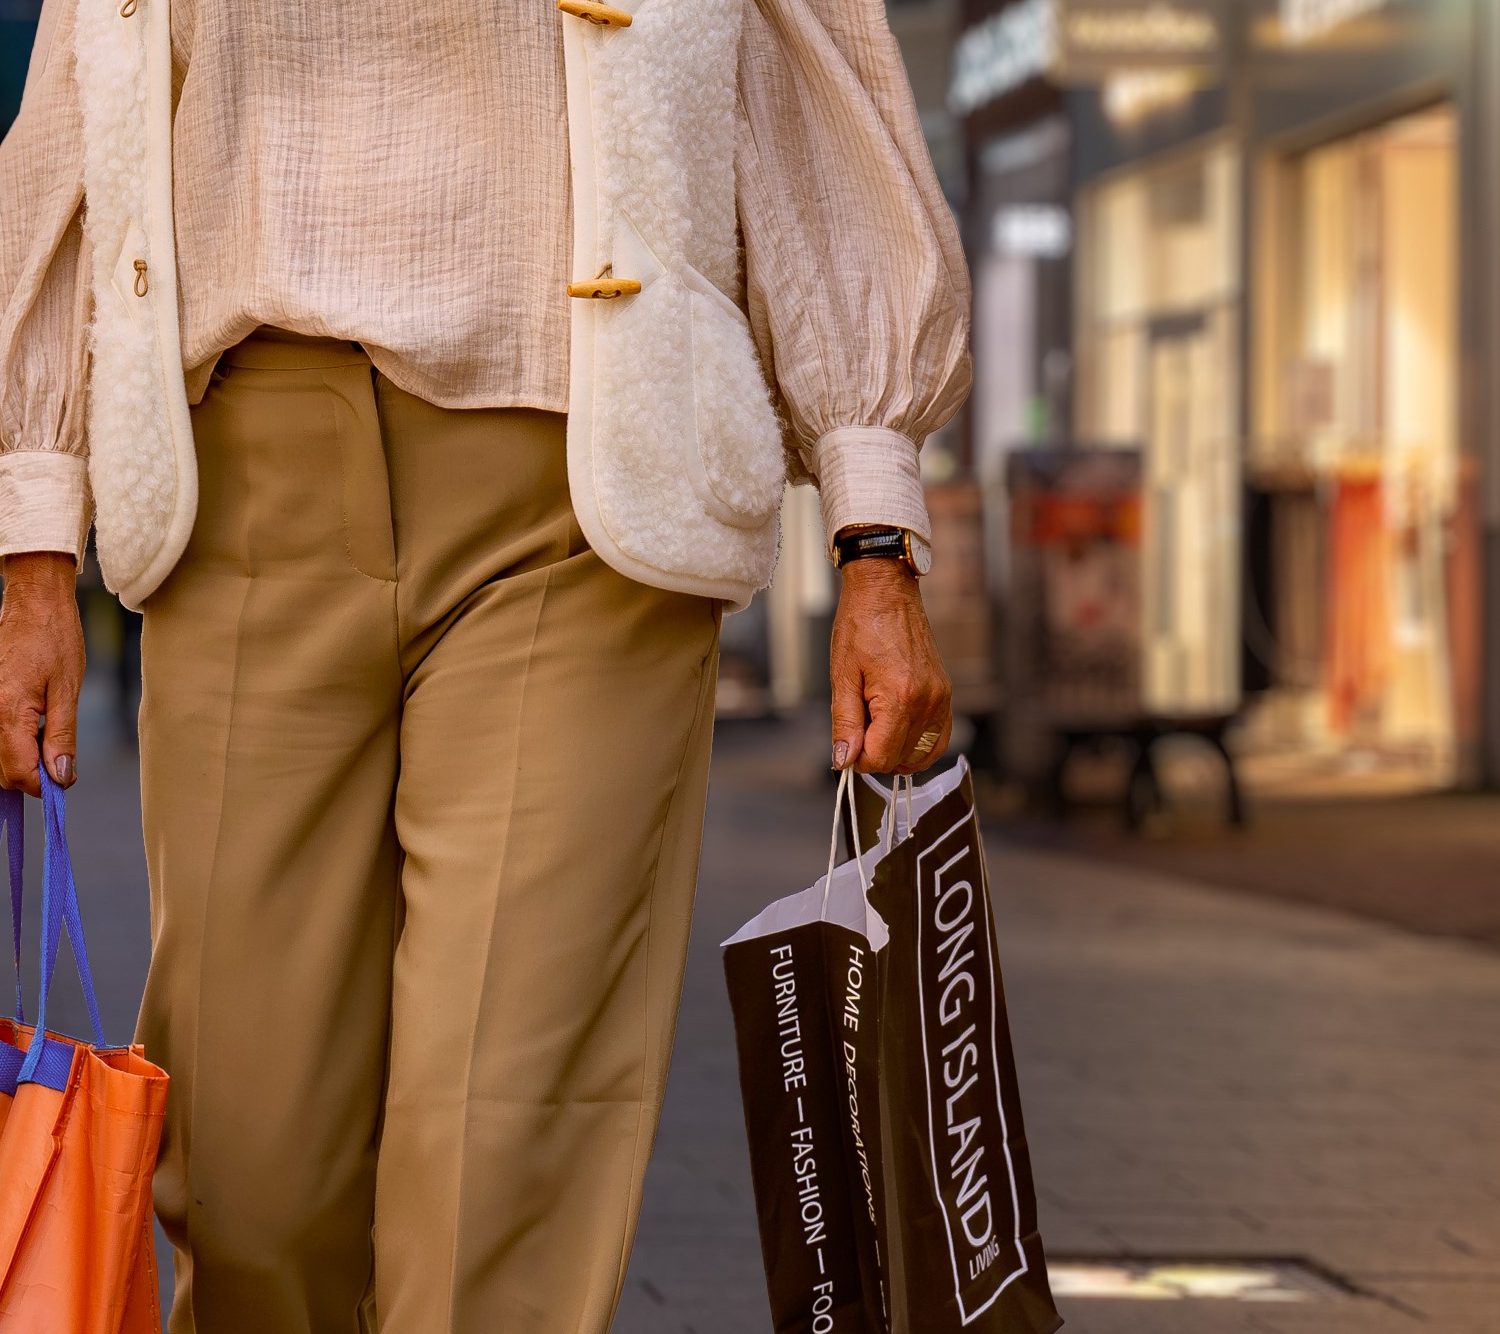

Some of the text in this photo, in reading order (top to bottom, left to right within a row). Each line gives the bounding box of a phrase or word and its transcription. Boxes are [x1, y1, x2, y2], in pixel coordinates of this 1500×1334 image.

[843, 944, 864, 1032] HOME
[934, 845, 993, 1248] LONG ISLAND
[770, 944, 807, 1092] FURNITURE
[790, 1127, 827, 1245] FASHION
[843, 1040, 877, 1224] DECORATIONS
[969, 1234, 1001, 1280] LIVING
